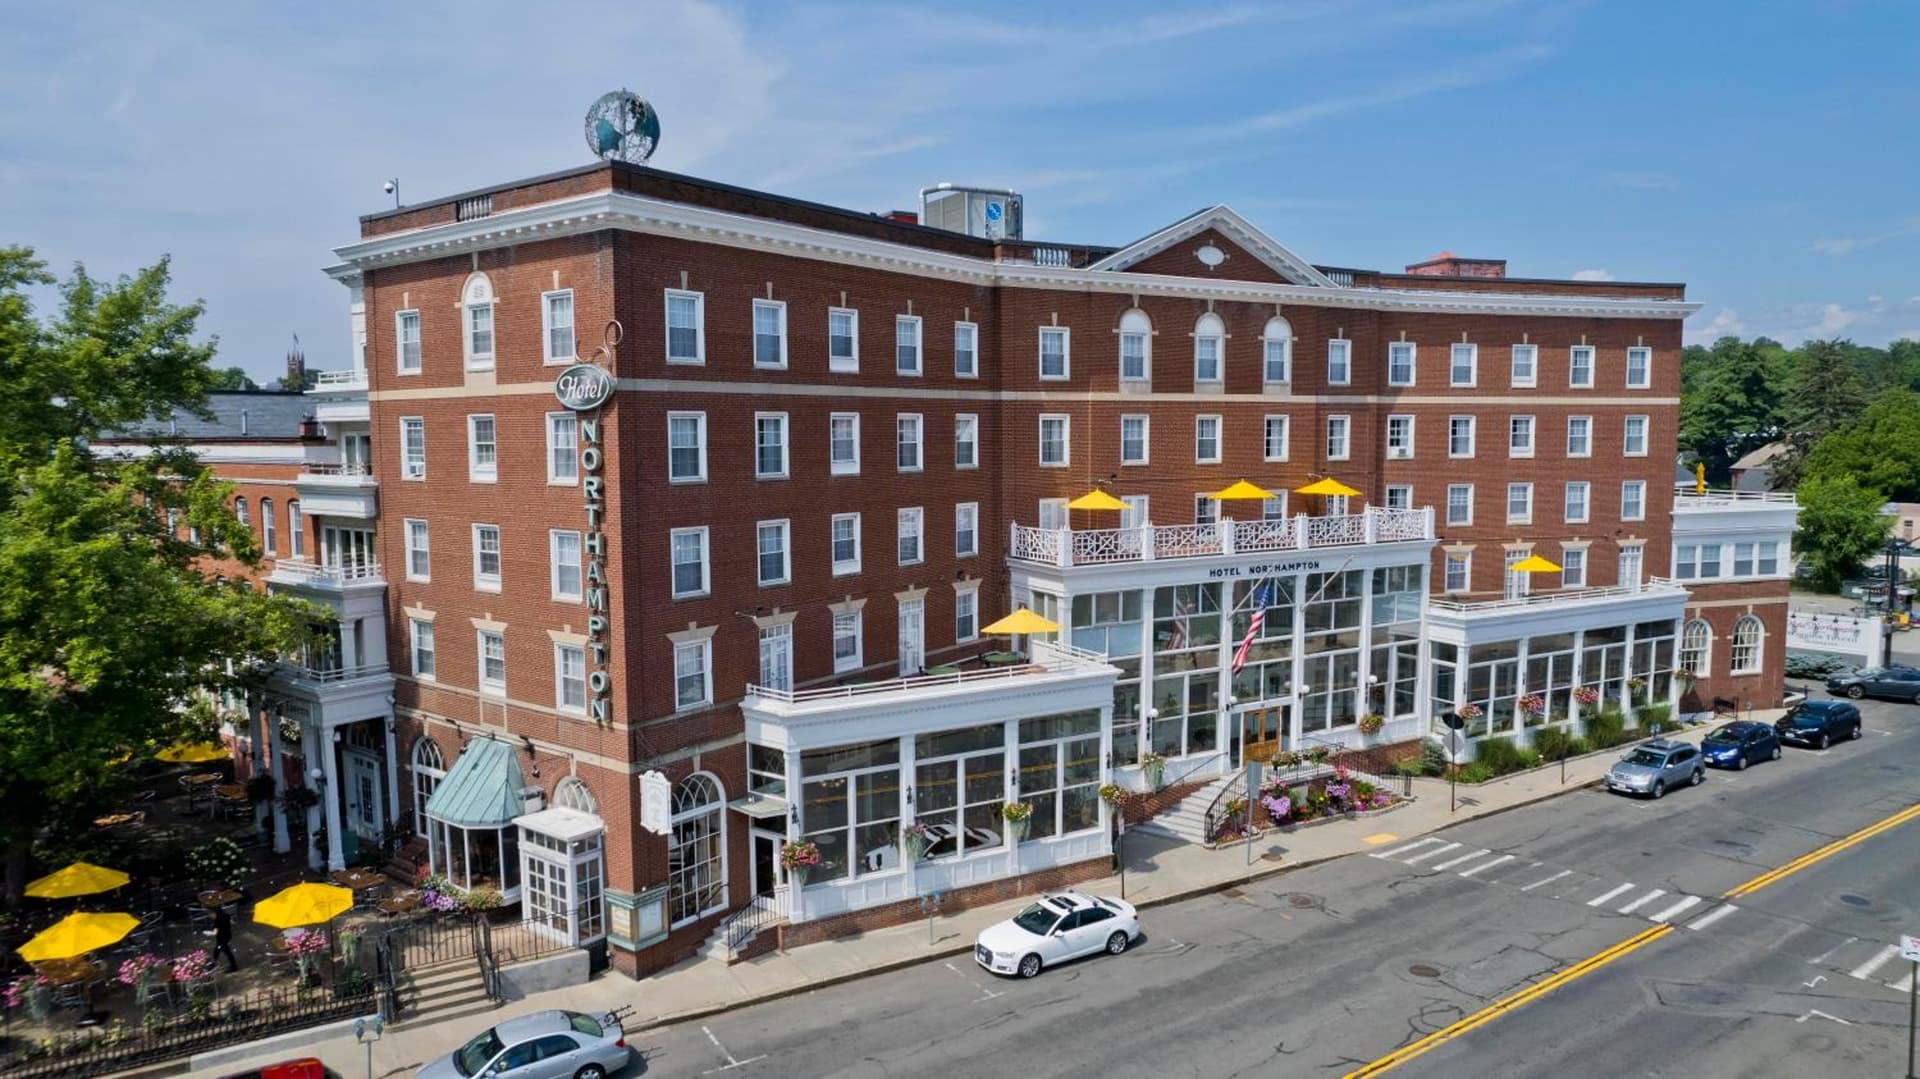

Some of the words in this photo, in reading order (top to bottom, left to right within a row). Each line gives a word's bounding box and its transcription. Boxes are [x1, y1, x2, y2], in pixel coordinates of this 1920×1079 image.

[560, 375, 604, 400] Hotel
[581, 419, 608, 721] NORTHAMPTON
[1209, 568, 1241, 577] HOTEL
